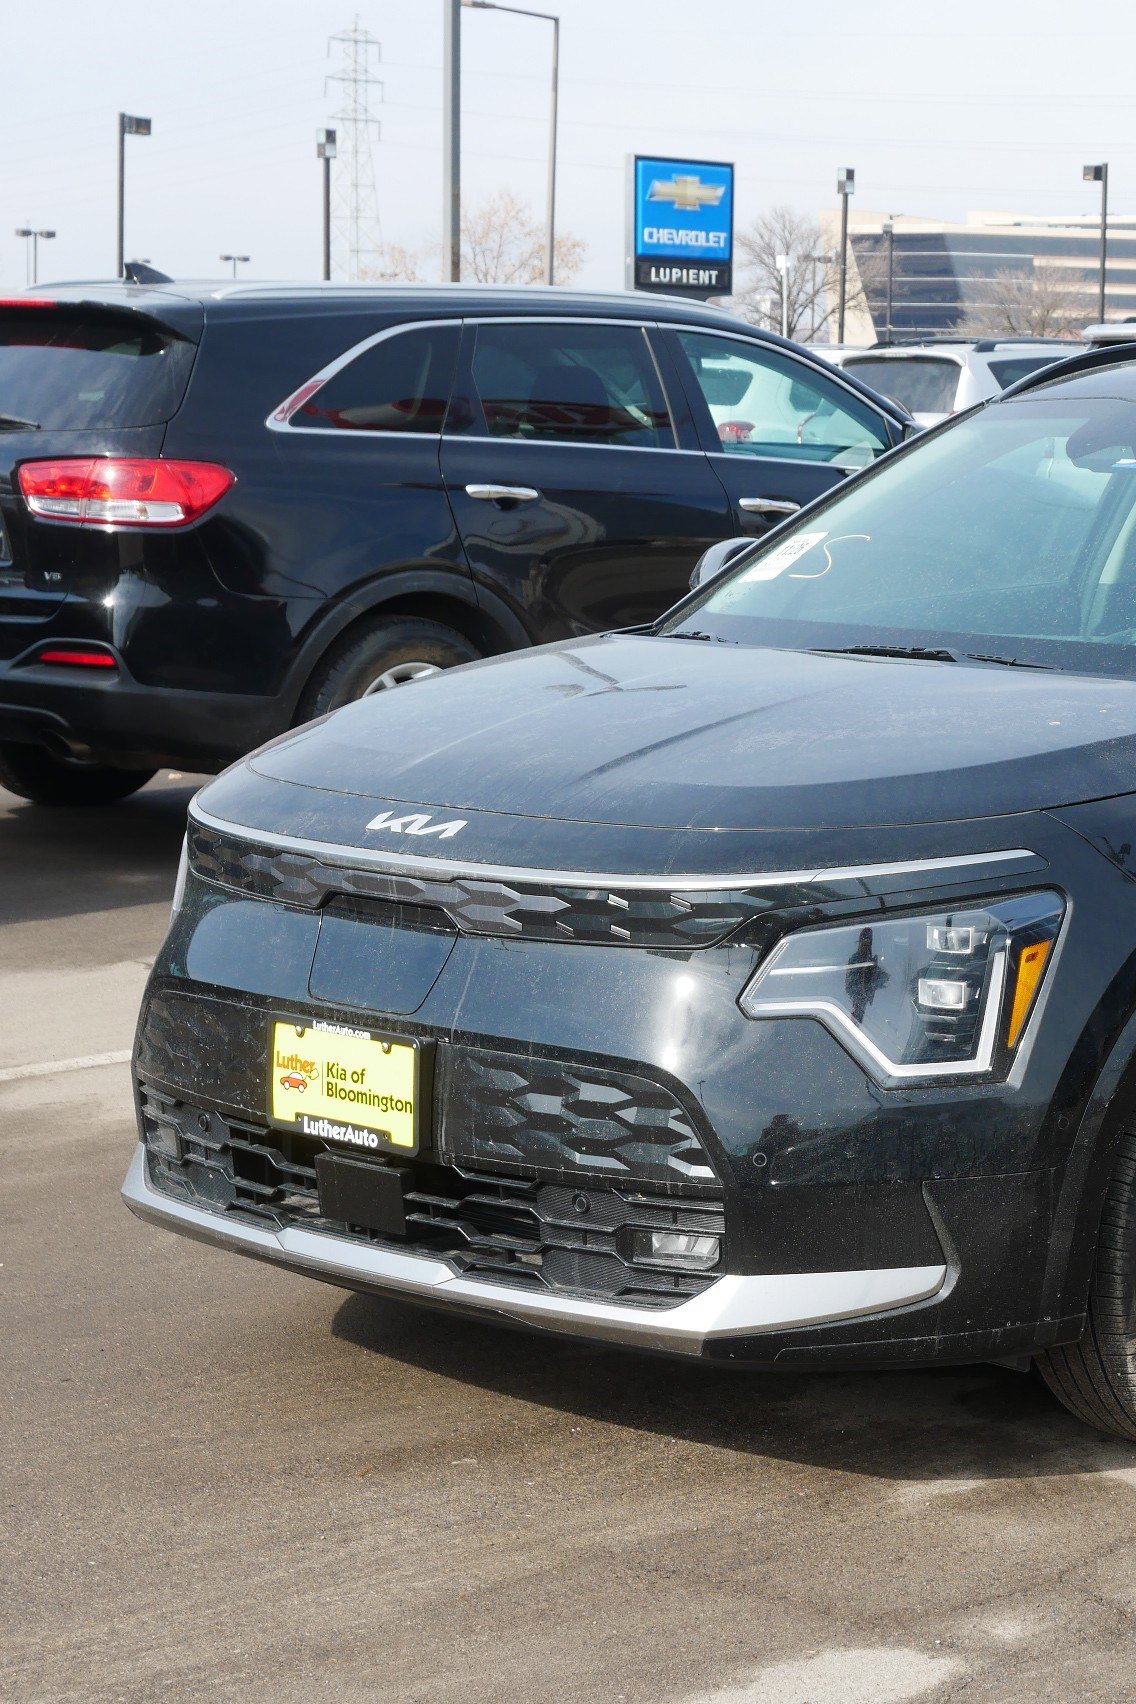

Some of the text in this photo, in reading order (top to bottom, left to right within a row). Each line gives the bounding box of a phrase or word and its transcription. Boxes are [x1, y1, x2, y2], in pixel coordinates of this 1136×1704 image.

[643, 227, 727, 248] CHEVROLET
[651, 266, 718, 286] LUPIENT
[365, 811, 468, 839] KIA
[312, 1019, 371, 1041] LutherAuto.com
[276, 1050, 315, 1073] Luther
[326, 1061, 366, 1085] Kia of
[326, 1081, 413, 1114] Bloomington
[303, 1115, 378, 1148] LutherAuto
